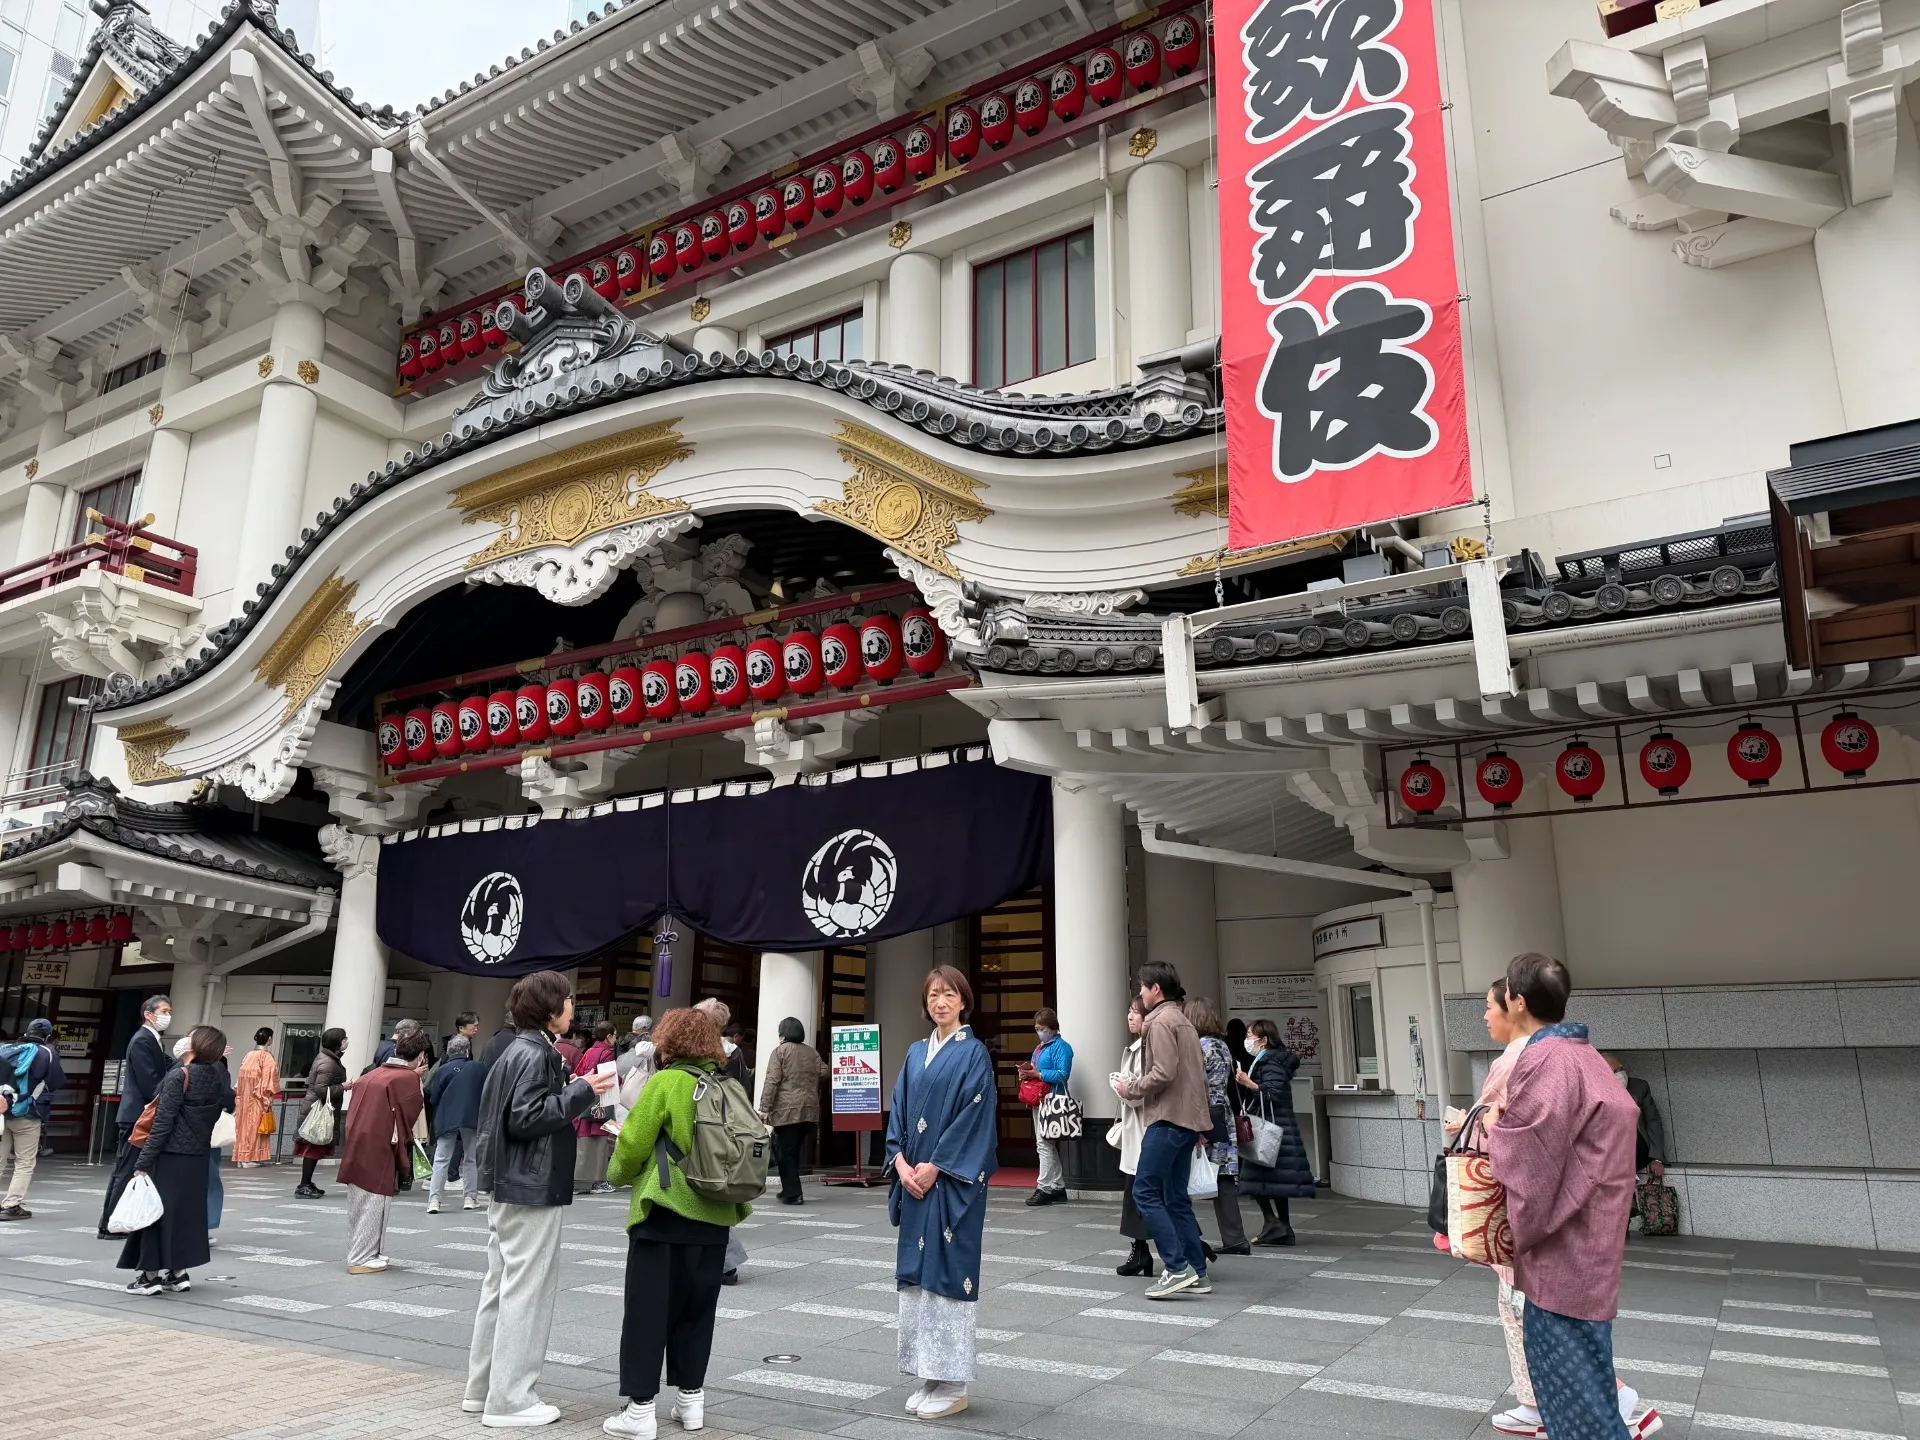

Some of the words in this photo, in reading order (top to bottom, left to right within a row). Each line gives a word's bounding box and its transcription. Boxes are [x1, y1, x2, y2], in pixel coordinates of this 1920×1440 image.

[28, 963, 62, 973] 一幕見席
[613, 1004, 630, 1016] 出口
[833, 1032, 870, 1042] 東銀座駅
[833, 1043, 864, 1051] お土産広場
